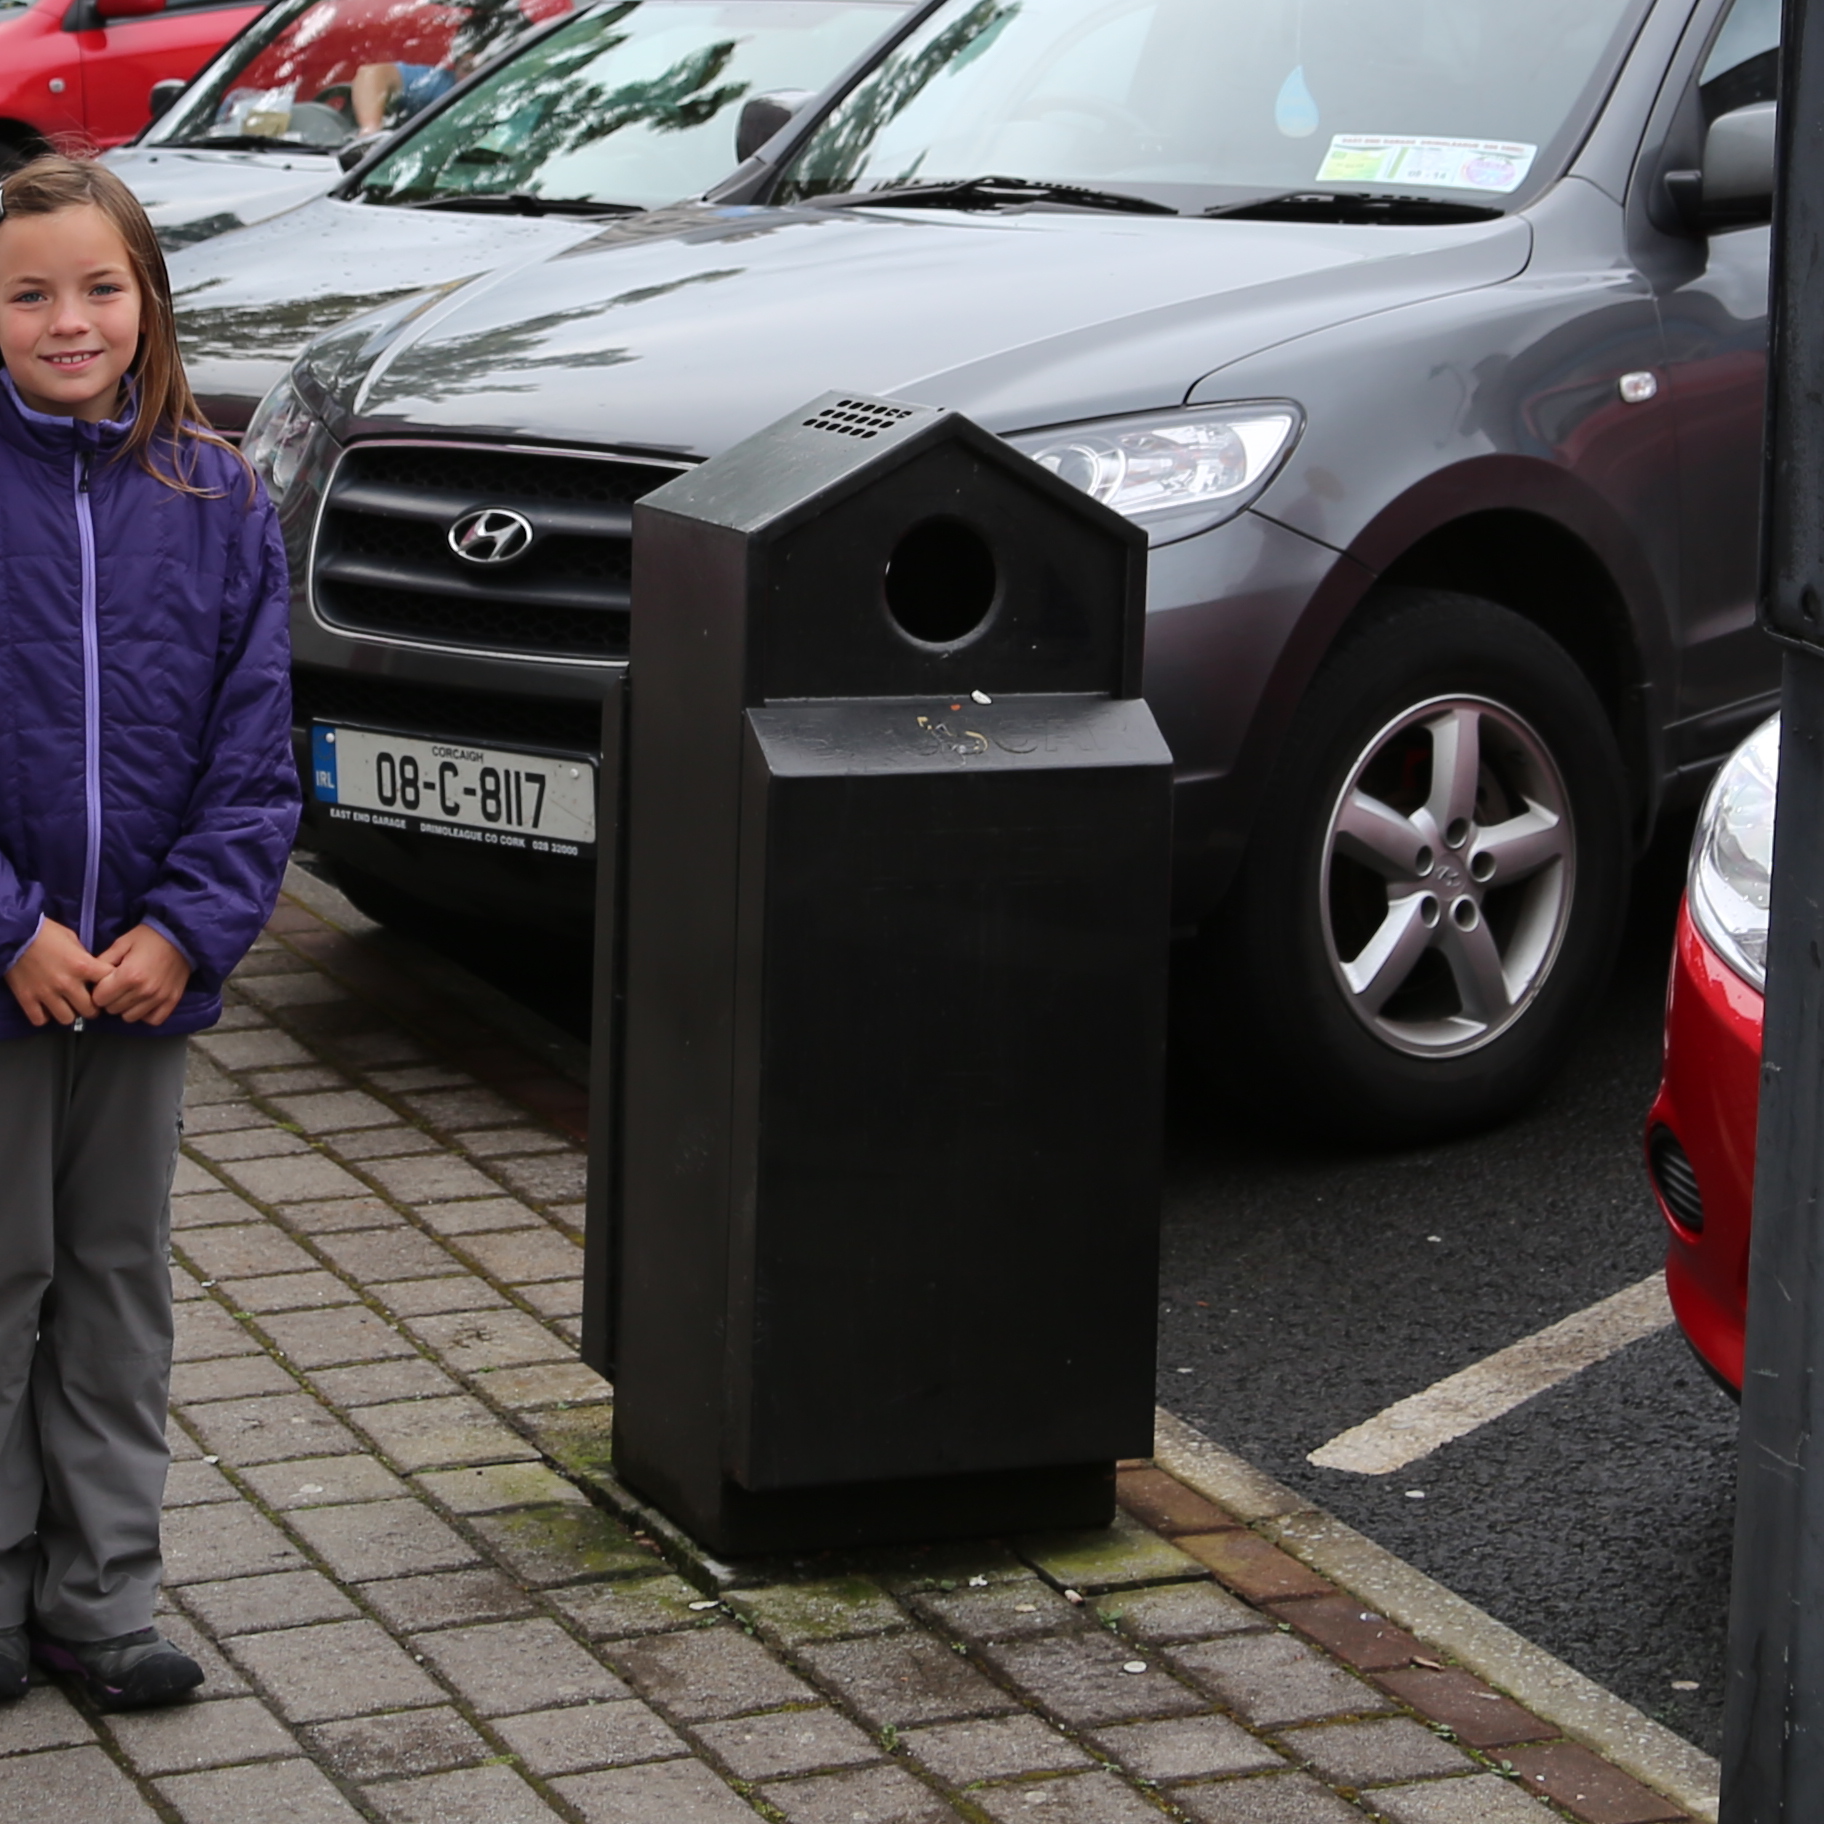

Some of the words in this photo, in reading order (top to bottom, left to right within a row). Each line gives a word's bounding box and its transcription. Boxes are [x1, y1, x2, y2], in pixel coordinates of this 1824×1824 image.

[431, 745, 484, 764] CORCAIGH
[315, 769, 336, 789] IRL
[376, 751, 547, 829] 08-C-8117
[329, 807, 352, 820] EAST
[353, 811, 371, 824] END
[372, 814, 407, 829] GARAGE
[420, 822, 484, 842] DRIMOLEAGUE
[484, 833, 498, 844] CO
[500, 835, 526, 848] CORK
[532, 840, 549, 852] 028
[551, 843, 579, 856] 32000
